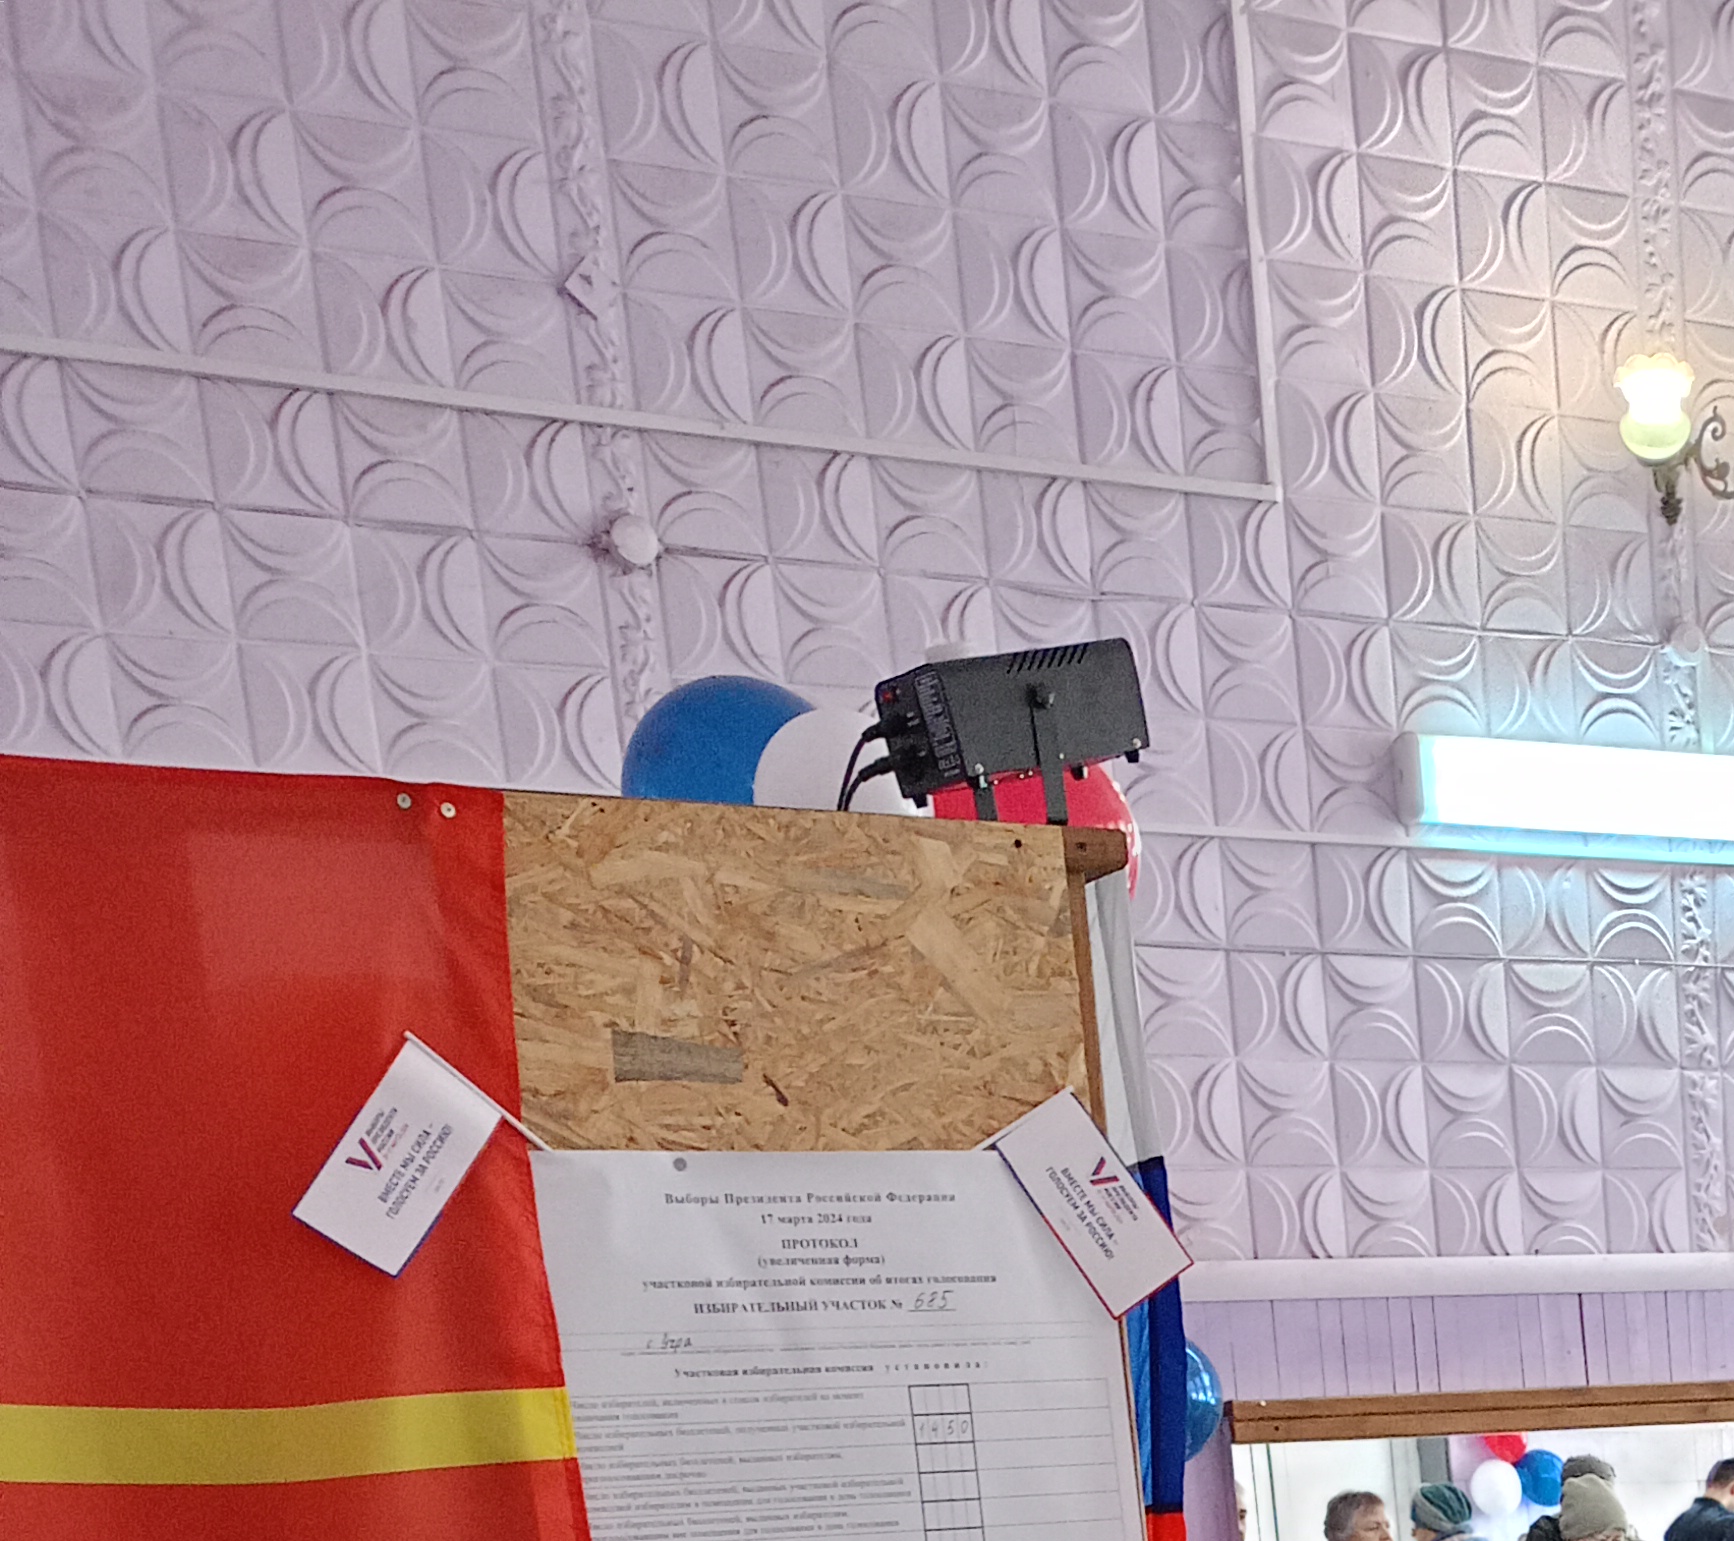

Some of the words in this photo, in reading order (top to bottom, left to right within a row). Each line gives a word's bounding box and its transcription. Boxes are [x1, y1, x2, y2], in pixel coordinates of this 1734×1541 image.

[377, 1169, 404, 1202] ВМЕСТЕ
[400, 1153, 415, 1169] МЫ
[411, 1129, 430, 1153] СИЛА
[385, 1175, 419, 1218] ГОЛОСУЕМ
[415, 1163, 427, 1175] ЗА
[664, 1192, 719, 1207] Выборы
[724, 1192, 802, 1207] Президента
[806, 1191, 882, 1204] Российской
[1061, 1168, 1087, 1200] ВМЕСТЕ
[1084, 1200, 1098, 1216] МЫ
[1096, 1216, 1115, 1238] СИЛА
[761, 1213, 774, 1224] 17
[778, 1215, 814, 1227] марта
[817, 1213, 843, 1224] 2024
[1045, 1167, 1079, 1210] ГОЛОСУЕМ
[1077, 1211, 1087, 1221] ЗА
[1084, 1221, 1115, 1259] РОССИЮ!
[781, 1237, 859, 1250] ПРОТОКОЛ
[842, 1254, 886, 1268] форма)
[642, 1278, 713, 1292] участковой
[716, 1276, 806, 1291] избирательной
[809, 1276, 867, 1287] комиссии
[869, 1274, 882, 1285] об
[693, 1299, 819, 1314] ИЗБИРАТЕЛЬНЫЙ
[822, 1298, 887, 1313] УЧАСТОК
